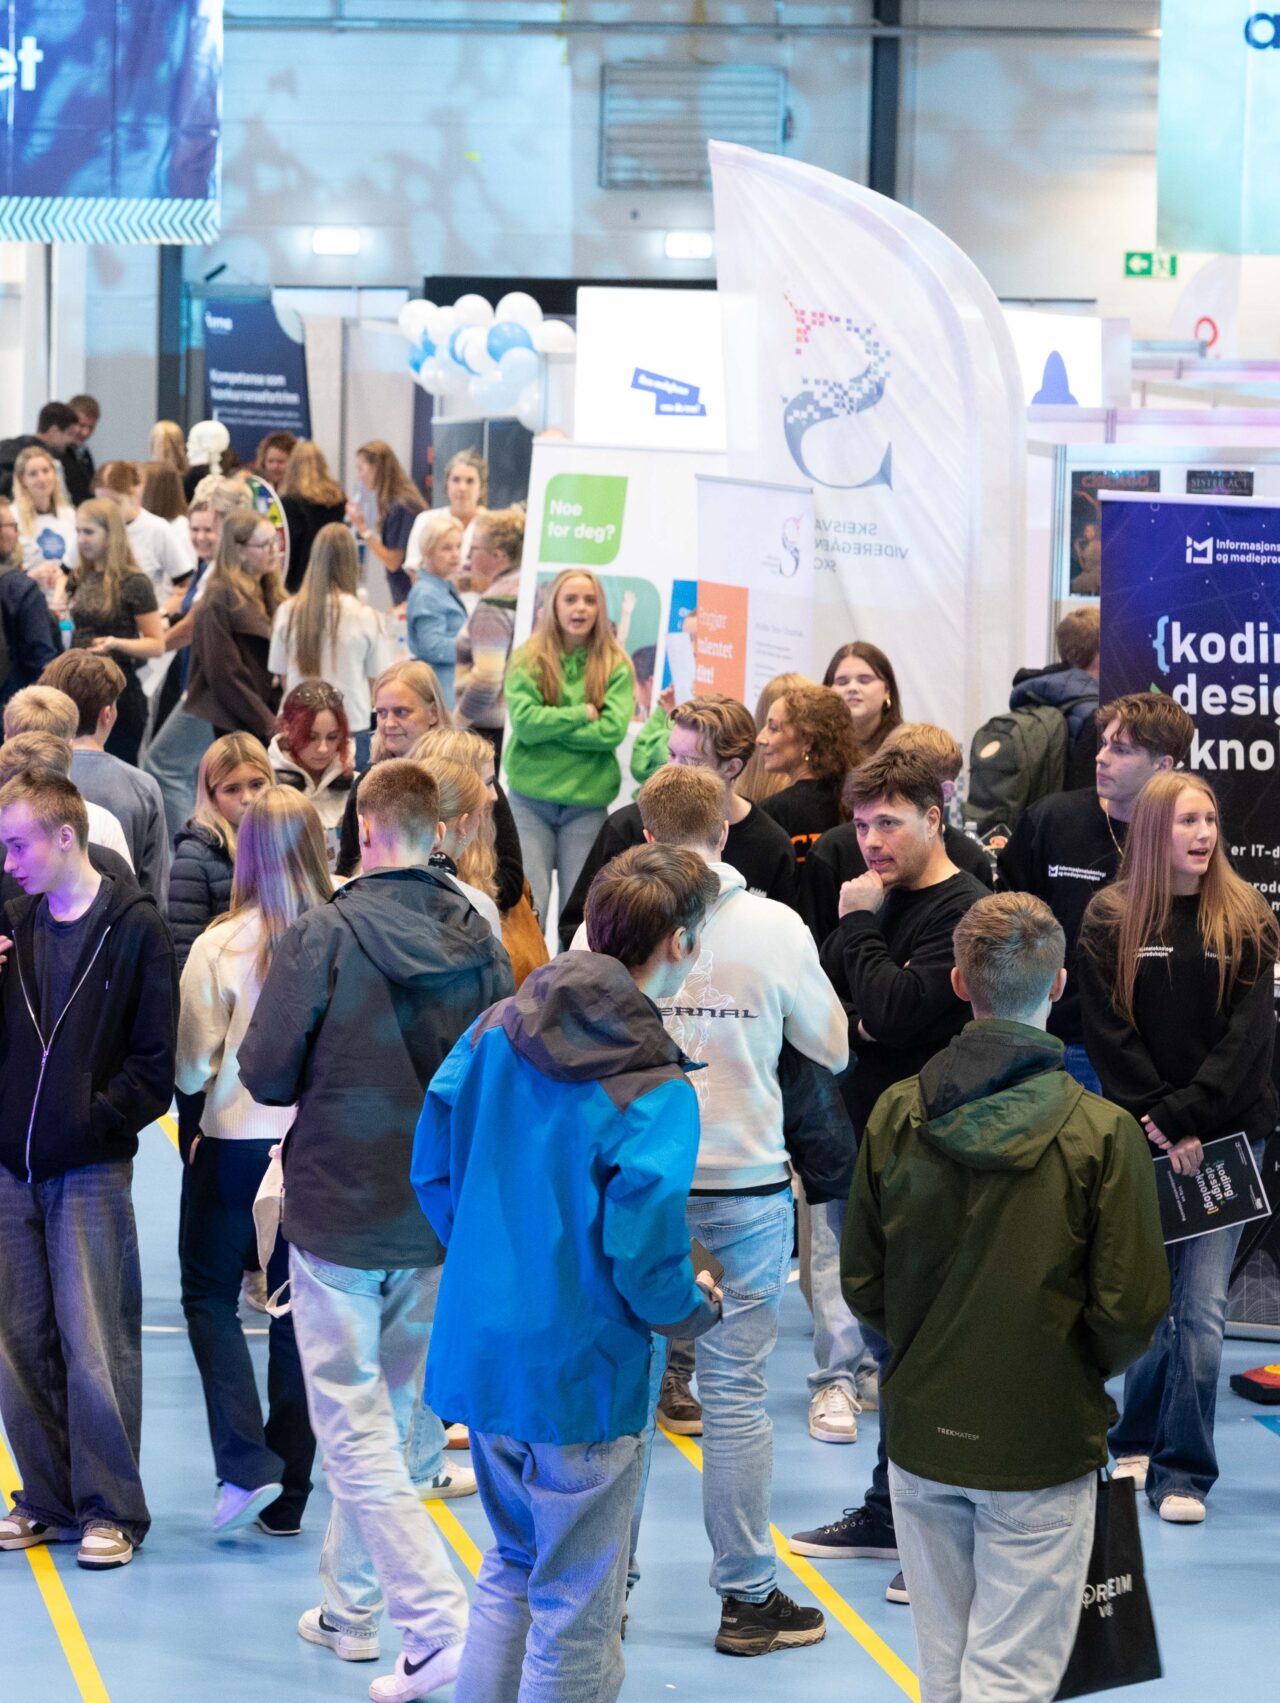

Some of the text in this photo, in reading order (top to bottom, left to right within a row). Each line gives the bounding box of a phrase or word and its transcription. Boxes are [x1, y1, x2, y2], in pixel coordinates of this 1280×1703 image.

[550, 500, 583, 516] Noe
[547, 522, 616, 544] for deg?
[1216, 553, 1229, 564] og
[1176, 728, 1280, 771] kno
[1231, 846, 1246, 856] er
[660, 1007, 760, 1018] ERNAL
